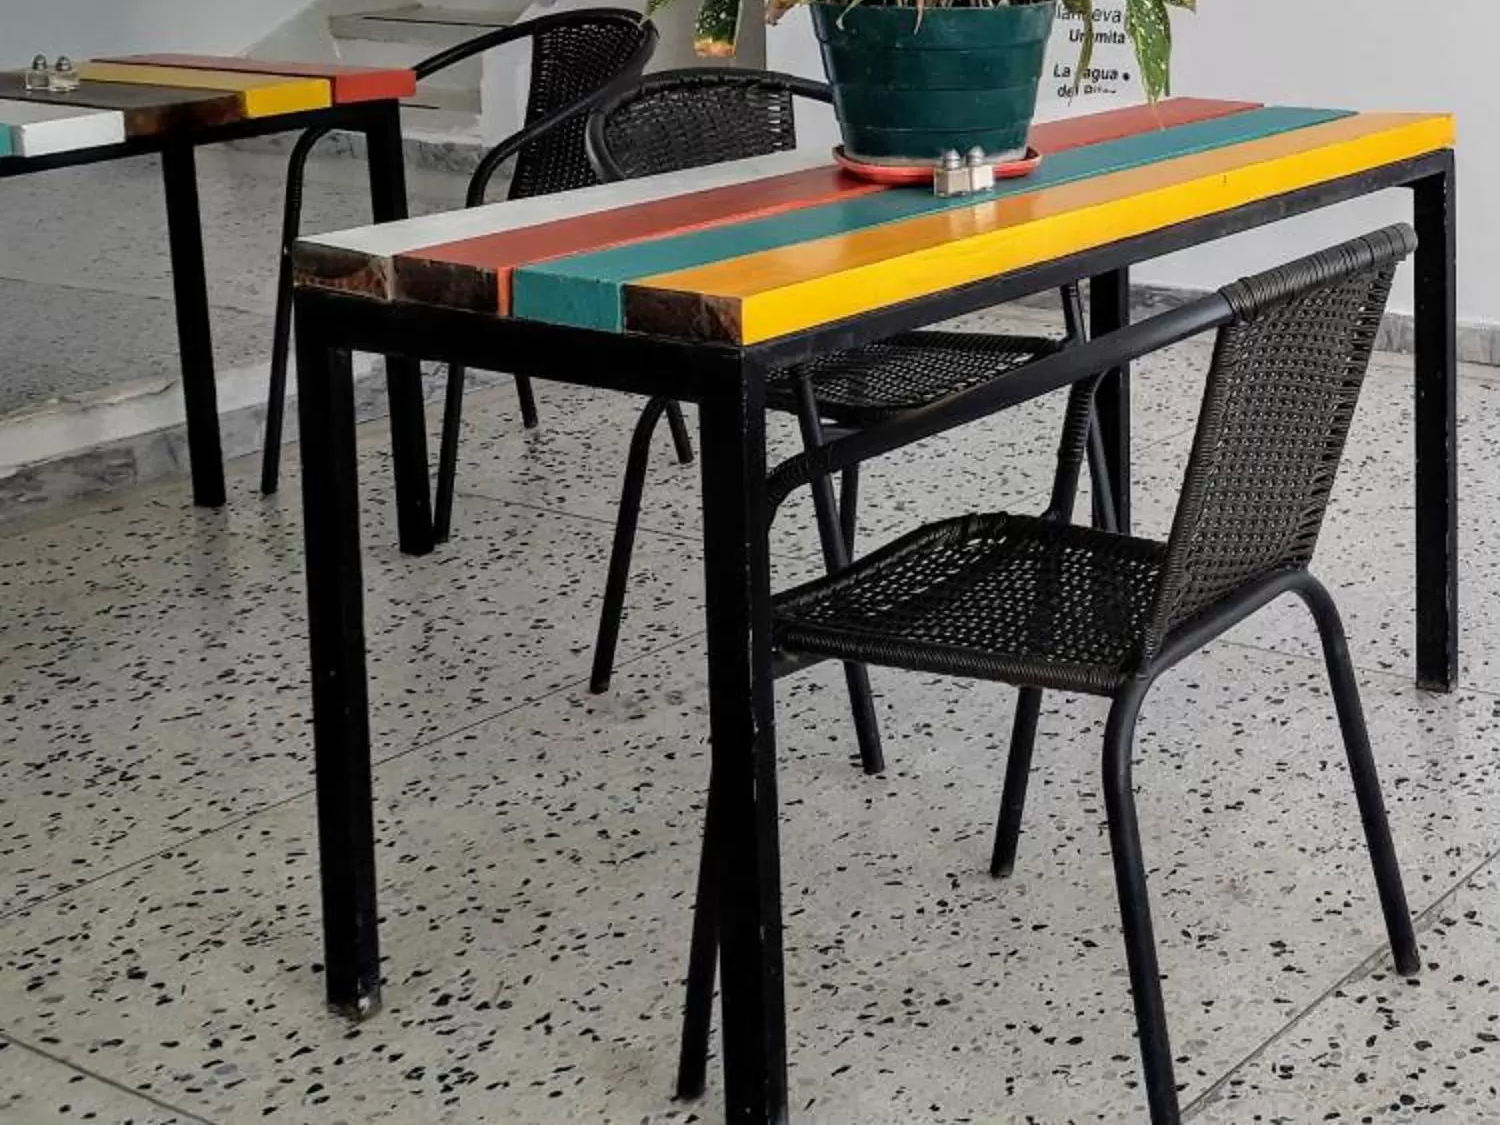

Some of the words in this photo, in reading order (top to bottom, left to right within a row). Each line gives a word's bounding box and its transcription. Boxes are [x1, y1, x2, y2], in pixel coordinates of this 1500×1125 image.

[1069, 28, 1125, 44] Urmita
[1053, 63, 1071, 78] La
[1082, 67, 1119, 84] agua
